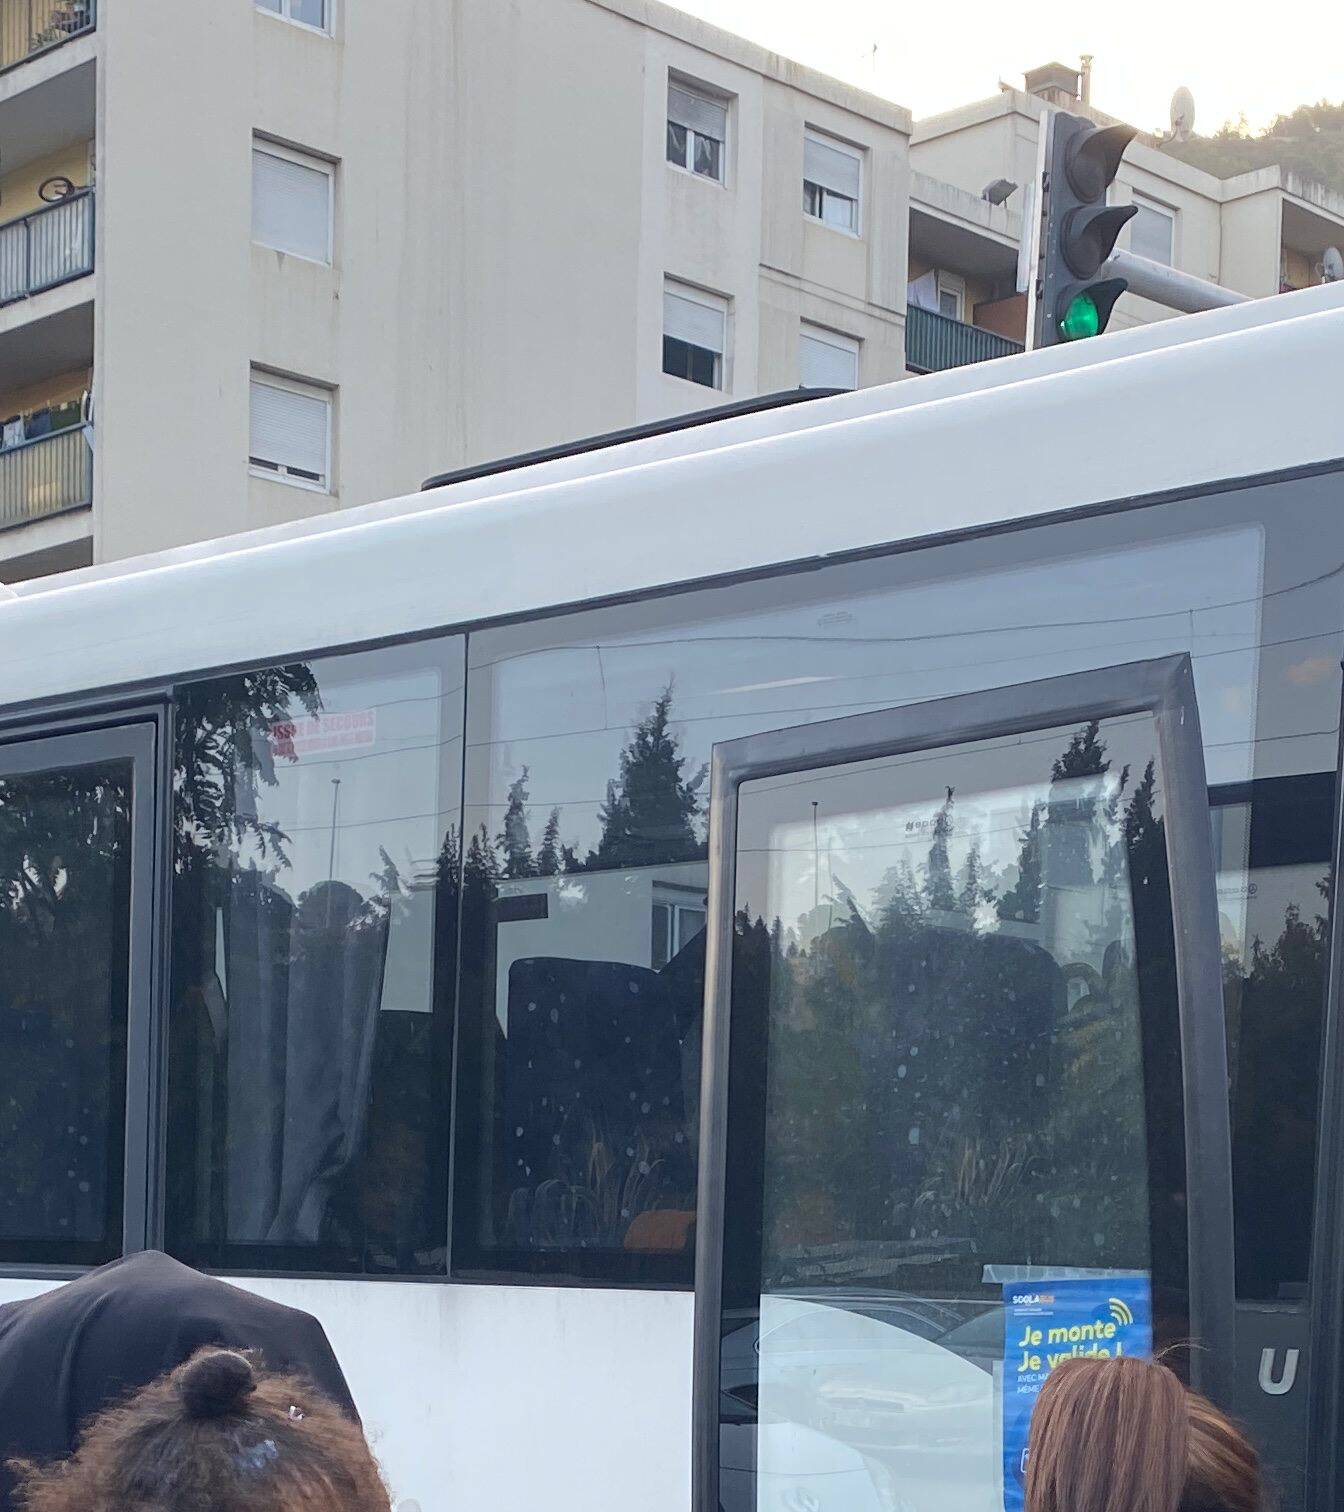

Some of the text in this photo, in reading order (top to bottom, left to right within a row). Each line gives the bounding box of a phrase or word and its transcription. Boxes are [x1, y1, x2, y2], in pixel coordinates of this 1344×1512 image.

[1018, 1319, 1117, 1347] Je monte
[1017, 1350, 1042, 1372] Je
